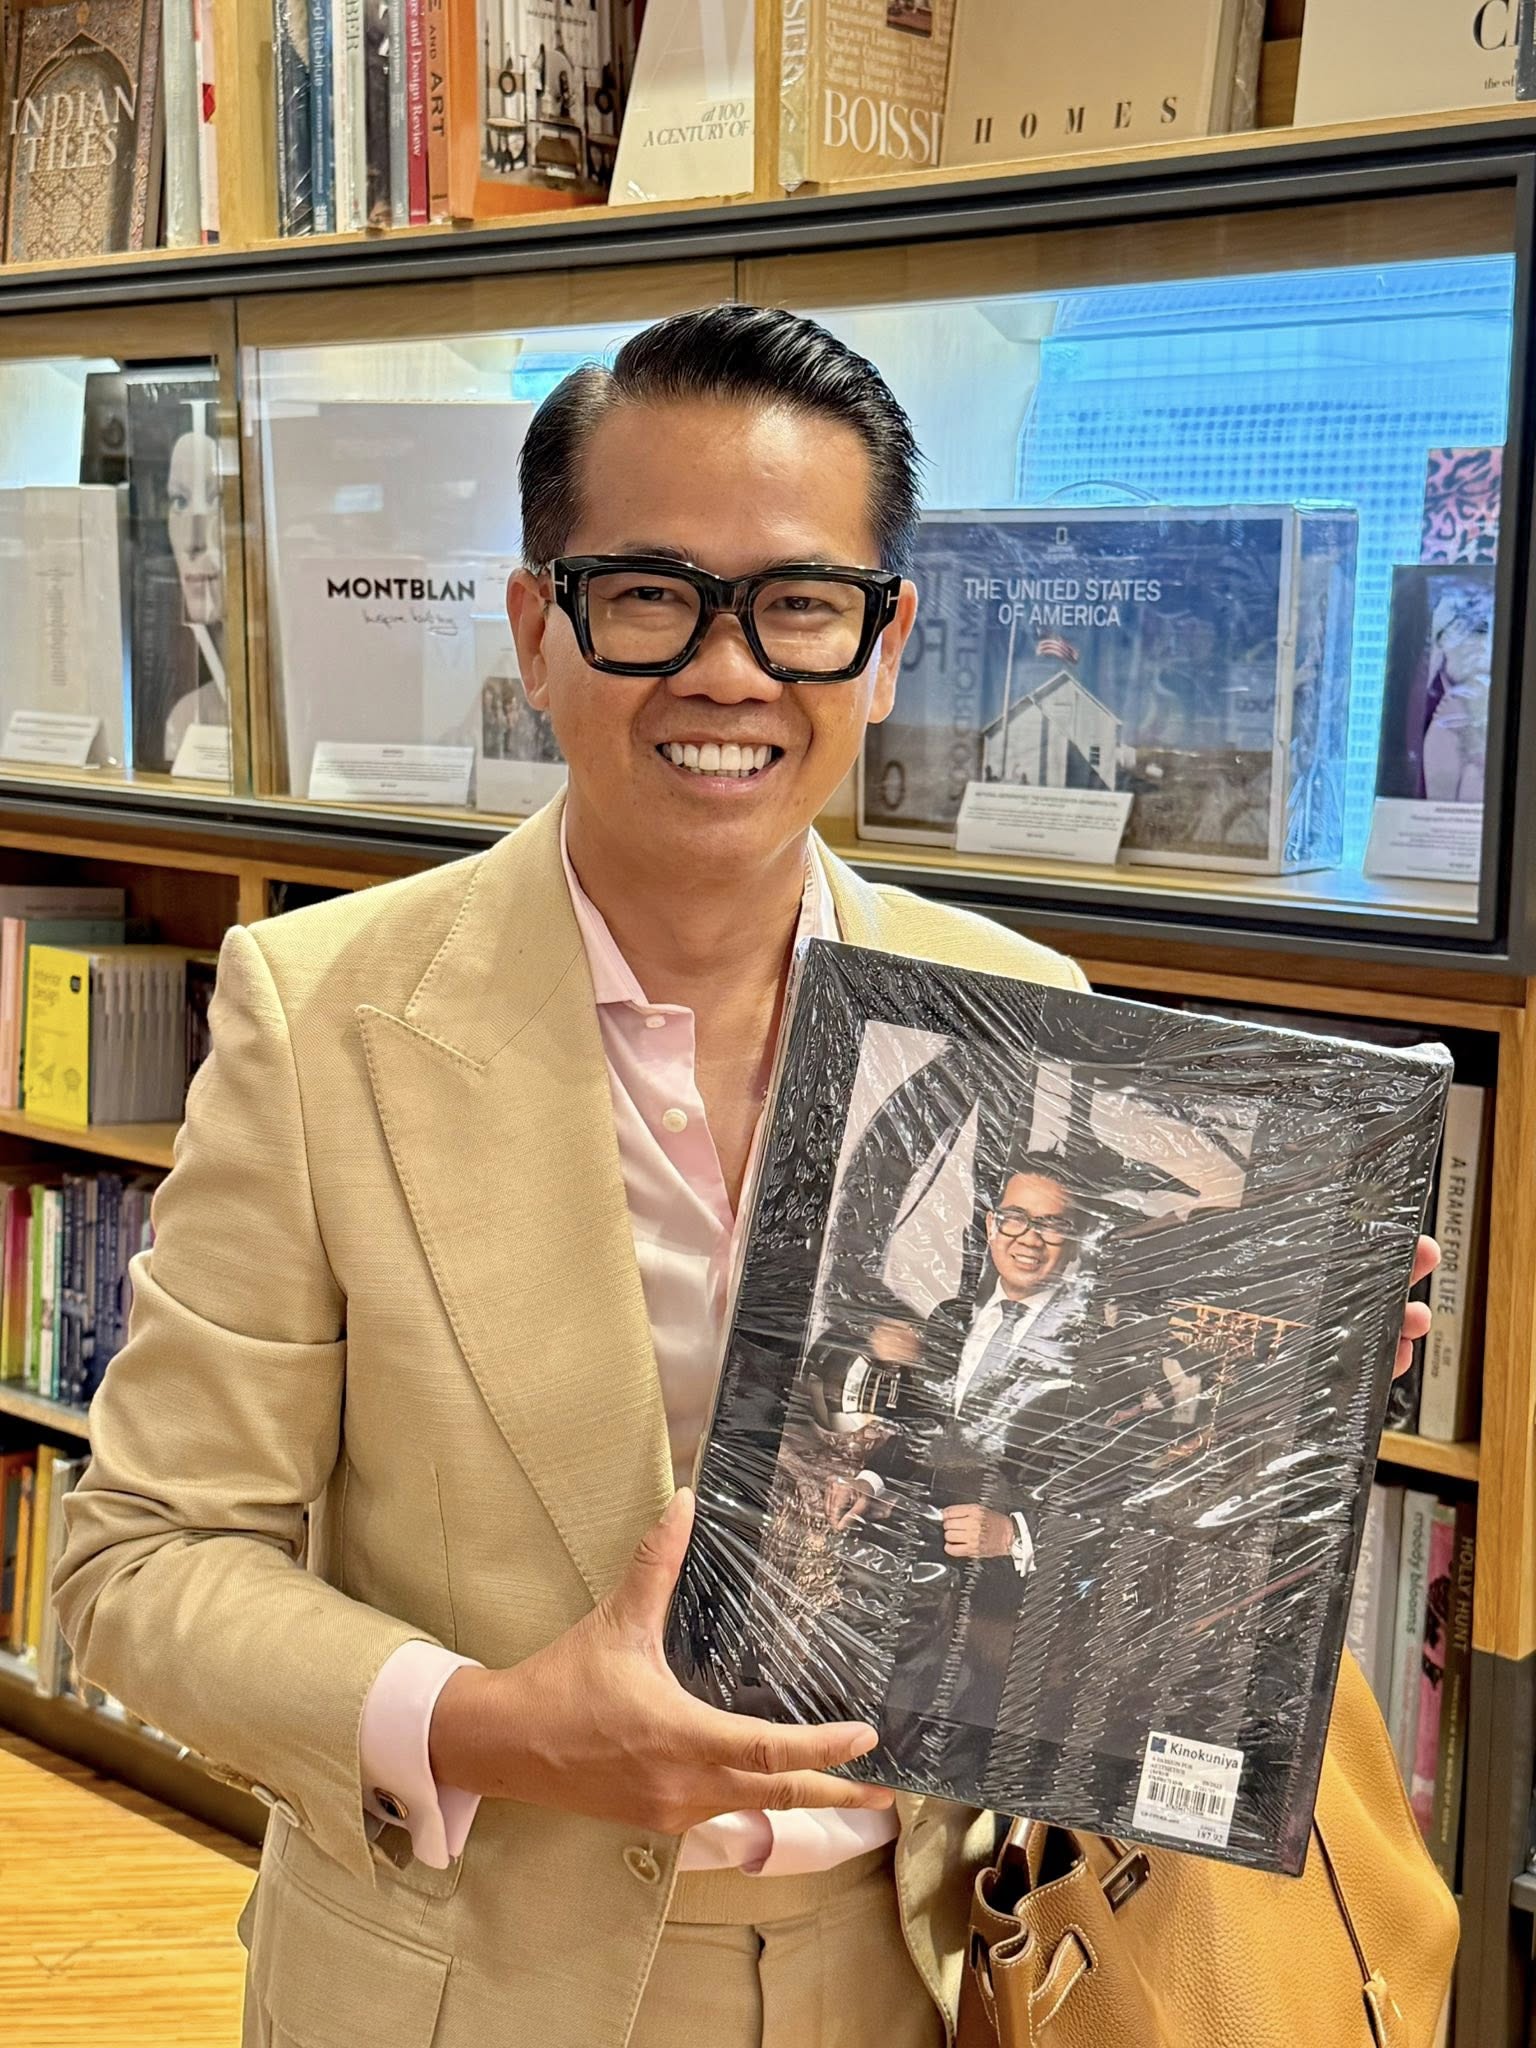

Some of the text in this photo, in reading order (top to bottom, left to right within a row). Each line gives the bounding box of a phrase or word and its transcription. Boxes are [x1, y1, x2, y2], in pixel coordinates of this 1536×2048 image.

[410, 21, 422, 47] and
[428, 26, 438, 60] AND
[409, 51, 423, 102] Design
[10, 84, 138, 135] INDIAN
[430, 71, 445, 137] ART
[701, 102, 745, 123] at 100
[975, 96, 1178, 145] HOMES
[25, 128, 118, 173] TILES
[411, 105, 424, 157] Review
[642, 119, 751, 148] A CENTURY OF
[327, 577, 476, 601] MONTBLAN
[963, 578, 1162, 602] THE UNITED STATES
[998, 603, 1121, 627] OF AMERICA
[1437, 1156, 1467, 1316] A FRAME FOR LIFE
[1408, 1511, 1424, 1567] moody
[1406, 1573, 1423, 1635] blooms
[1453, 1536, 1475, 1655] HOLLY HUNT
[1169, 1742, 1239, 1770] Kinokuniya
